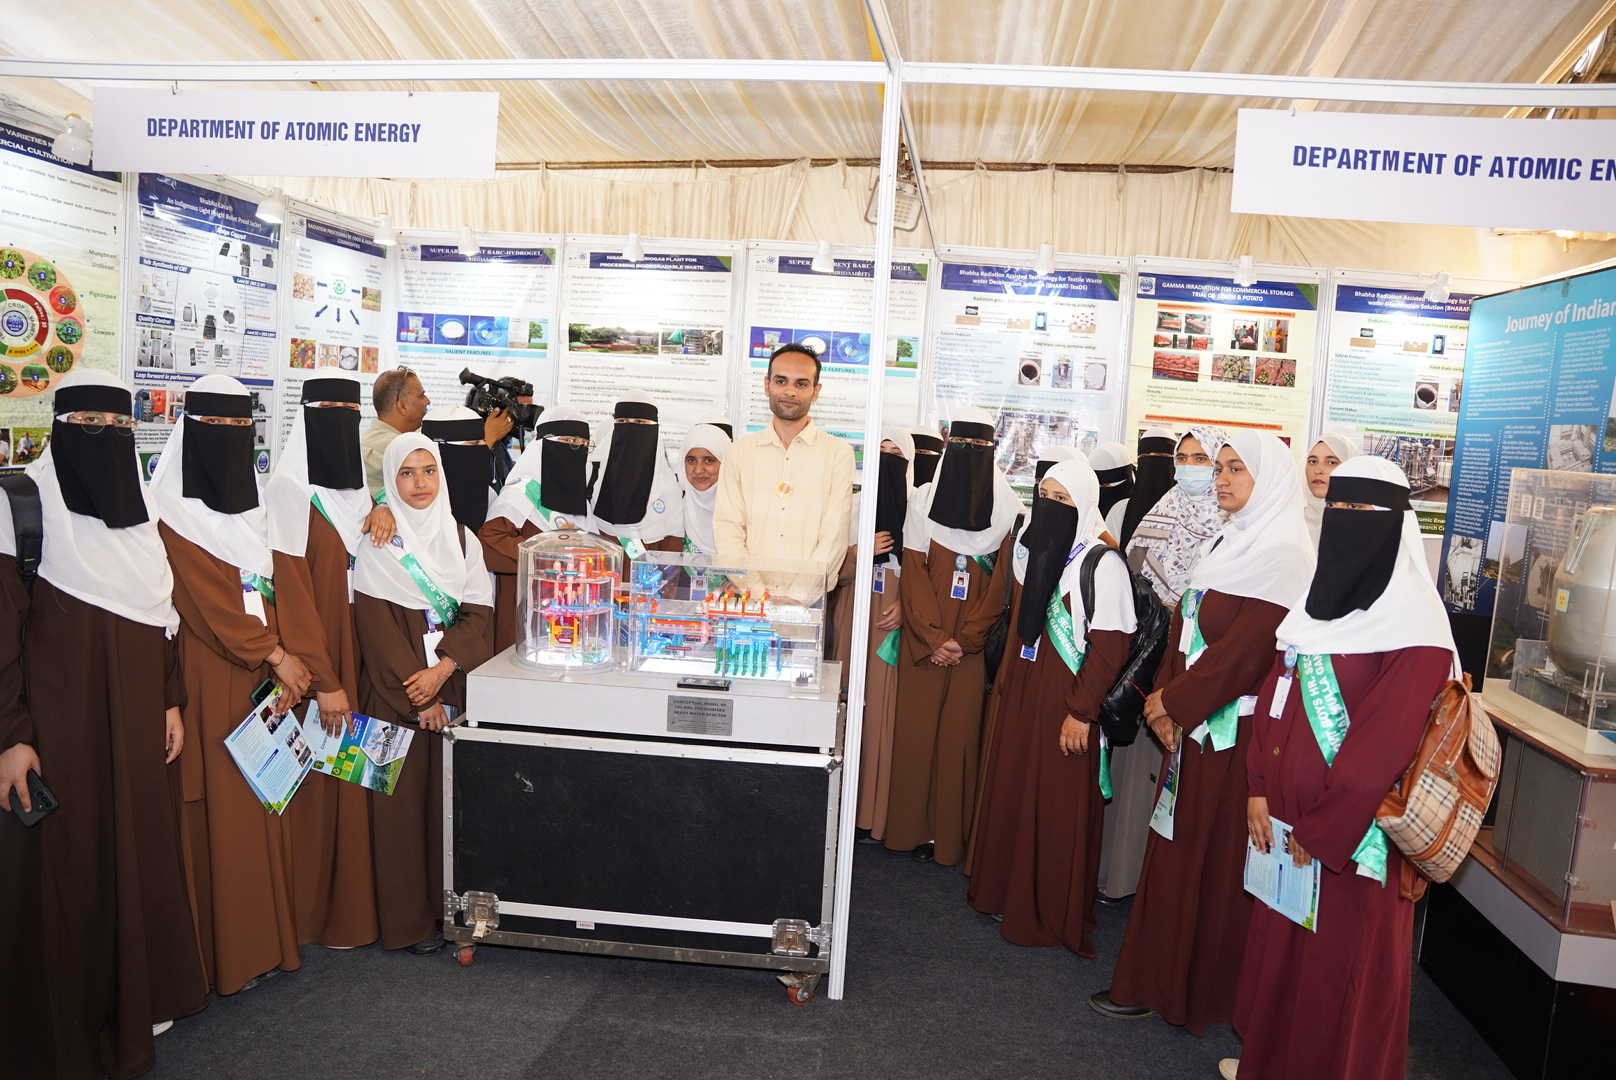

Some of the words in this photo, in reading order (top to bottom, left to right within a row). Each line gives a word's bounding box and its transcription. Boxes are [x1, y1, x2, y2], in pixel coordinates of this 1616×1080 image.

[6, 128, 47, 146] VARIETIES
[147, 118, 255, 140] DEPARTMENT
[260, 121, 280, 140] OF
[285, 122, 349, 142] ATOMIC
[354, 123, 421, 143] ENERGY
[0, 140, 26, 152] RCIAL
[27, 146, 73, 166] CULTIVATION
[1292, 145, 1447, 175] DEPARTMENT
[1454, 154, 1482, 176] OF
[1488, 156, 1582, 180] ATOMIC
[174, 198, 198, 212] Indigenous
[199, 206, 210, 215] Light
[225, 213, 237, 222] Bullet
[308, 223, 326, 232] RADIATION
[89, 249, 116, 259] Mungbean
[92, 262, 114, 270] Urdbean
[152, 261, 173, 269] Synthesis
[1029, 274, 1058, 283] Technology
[89, 290, 116, 300] Pigeonpea
[1185, 284, 1221, 292] IRRADIATION
[34, 302, 44, 317] Pulses
[138, 316, 154, 324] Quality
[1505, 312, 1554, 333] Journey
[1555, 303, 1570, 325] of
[1050, 619, 1082, 663] GANDERBAL
[1312, 698, 1332, 729] BOYS
